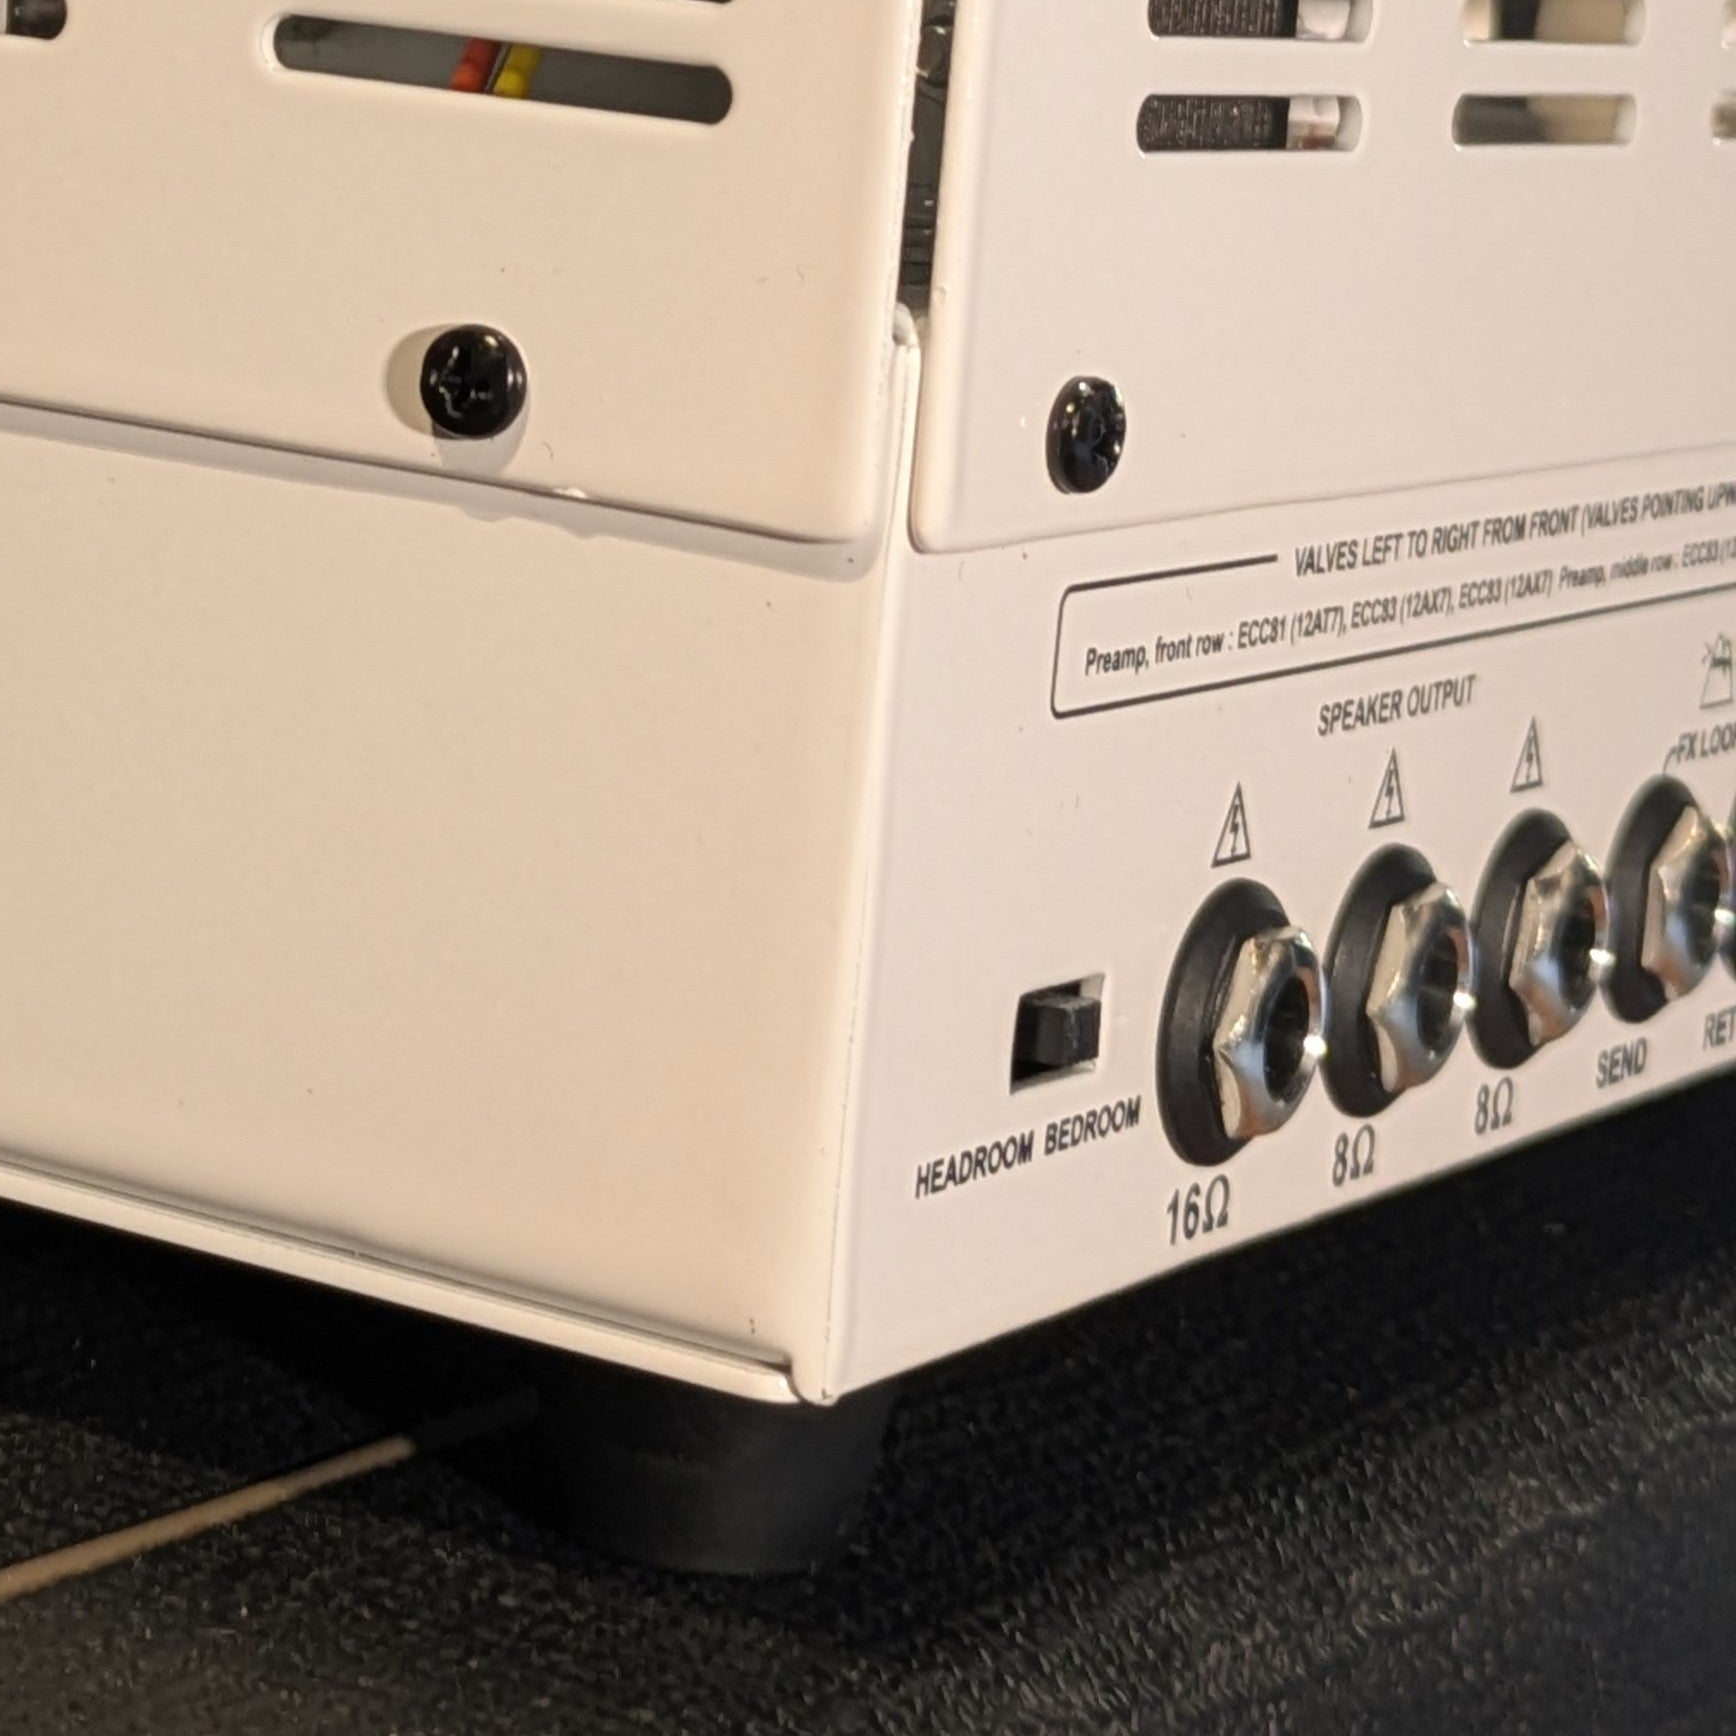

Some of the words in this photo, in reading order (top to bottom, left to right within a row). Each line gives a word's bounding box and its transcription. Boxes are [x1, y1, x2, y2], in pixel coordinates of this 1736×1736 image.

[1295, 538, 1358, 577] VALVES
[1362, 532, 1404, 567] LEFT
[1407, 528, 1428, 559] TO
[1431, 520, 1479, 555] RIGHT
[1482, 513, 1527, 547] FROM
[1529, 504, 1580, 540] FRONT
[1581, 495, 1639, 537] (VALVES
[1641, 485, 1705, 521] POINTING
[1085, 647, 1150, 677] Preamp,
[1154, 634, 1193, 665] front
[1195, 632, 1225, 658] row
[1237, 614, 1287, 649] ECC81
[1350, 595, 1398, 630] ECC83
[1458, 576, 1503, 610] ECC83
[1504, 568, 1554, 606] (12AX7)
[1317, 688, 1404, 737] SPEAKER
[1407, 673, 1477, 717] OUTPUT
[1677, 731, 1699, 763] FX
[1700, 720, 1736, 758] LOO
[1596, 1036, 1647, 1090] SEND
[1475, 1076, 1514, 1136] 8Ω
[915, 1129, 1035, 1199] HEADROOM
[1044, 1095, 1142, 1156] BEDROOM
[1332, 1123, 1376, 1187] 8Ω
[1166, 1173, 1231, 1246] 16Ω
